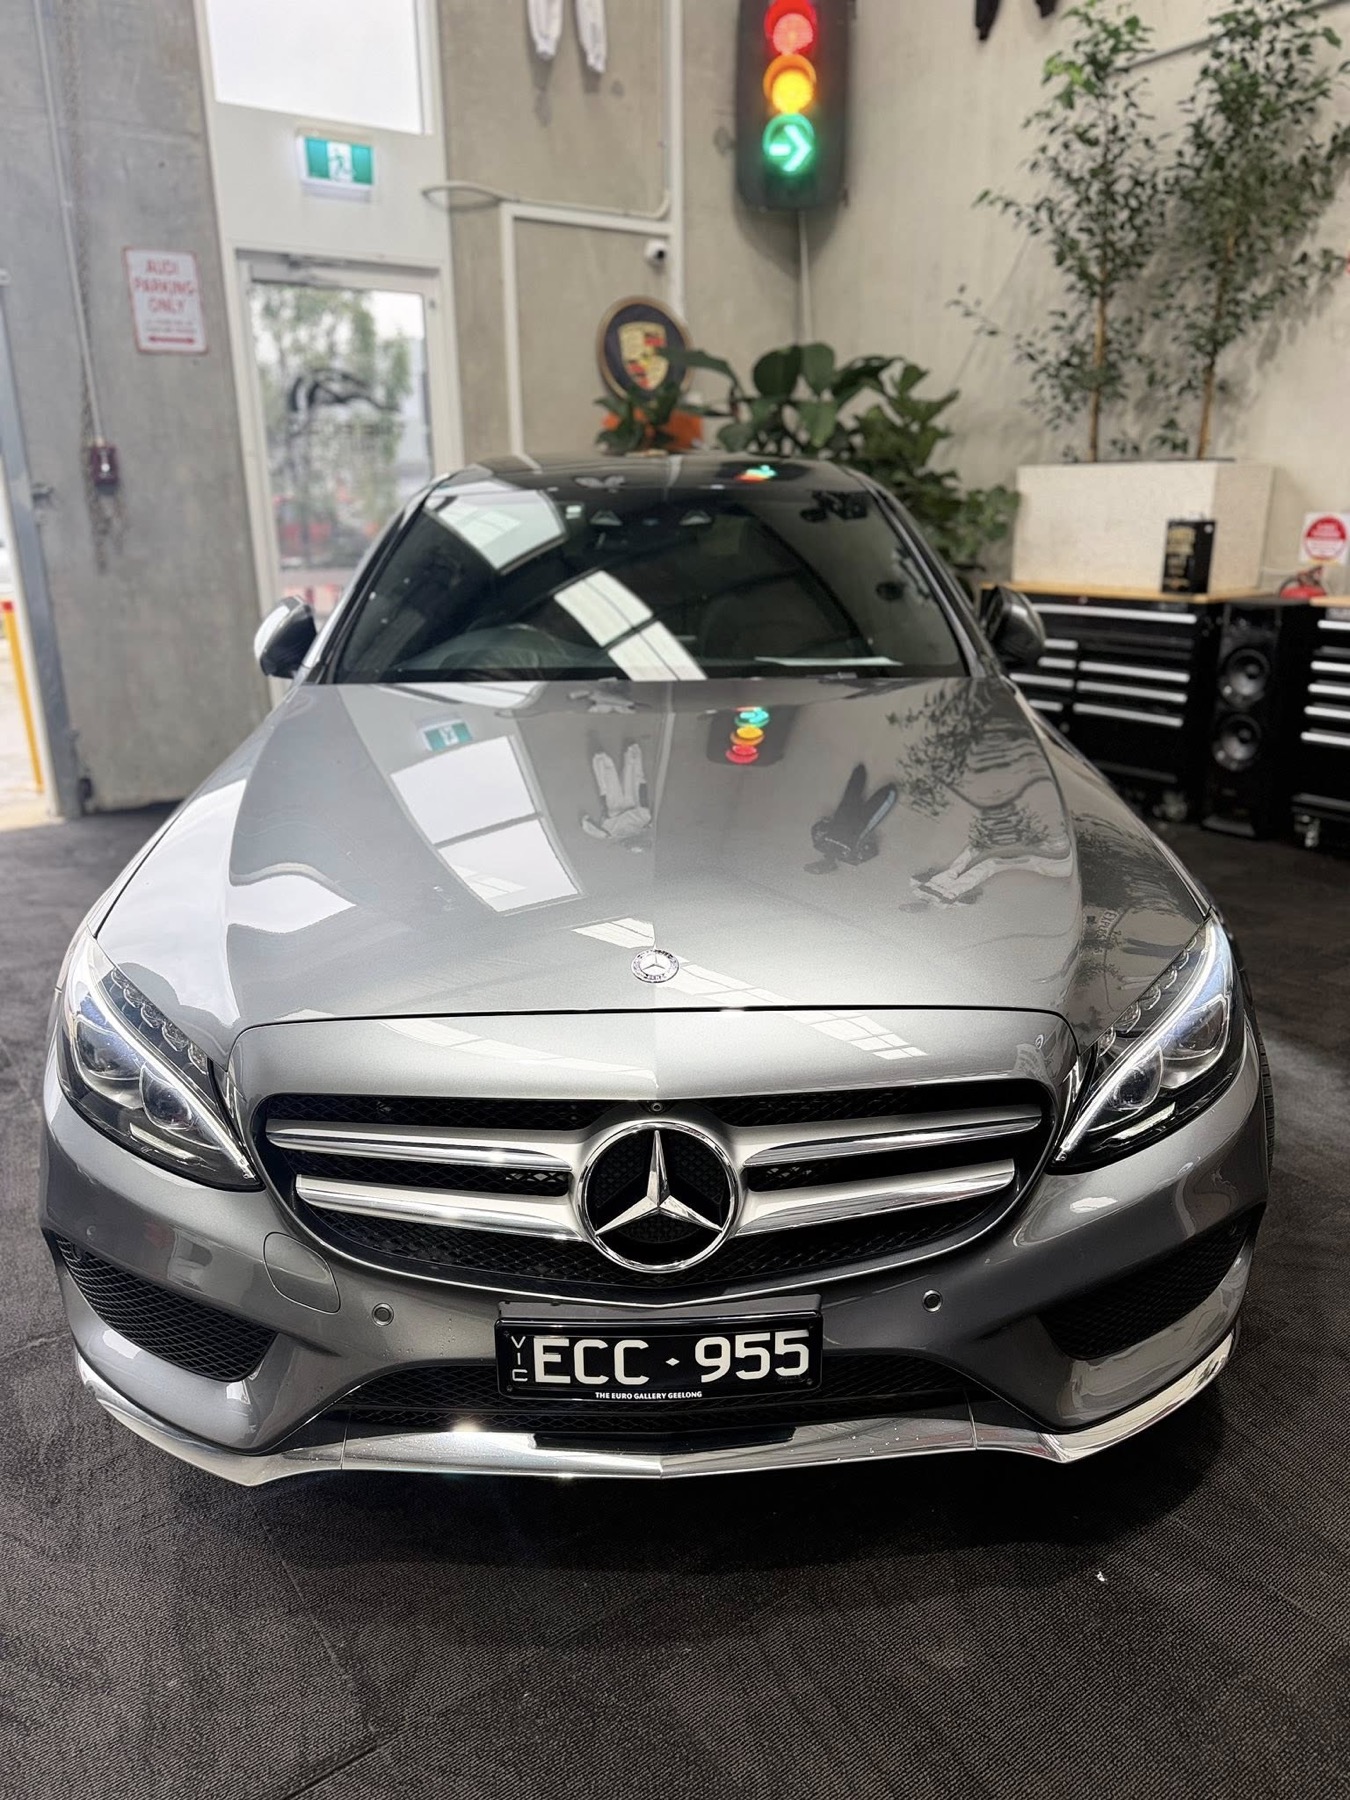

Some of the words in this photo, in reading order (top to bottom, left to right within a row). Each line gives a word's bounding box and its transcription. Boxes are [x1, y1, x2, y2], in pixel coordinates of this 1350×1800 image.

[133, 277, 195, 296] PARKING
[147, 297, 187, 314] ONLY
[511, 1336, 528, 1382] VIC
[533, 1337, 650, 1385] ECC
[694, 1329, 810, 1383] 955
[595, 1391, 610, 1399] THE
[611, 1392, 633, 1400] EURO
[633, 1392, 667, 1400] GALLERY
[667, 1390, 703, 1399] GEELONG
